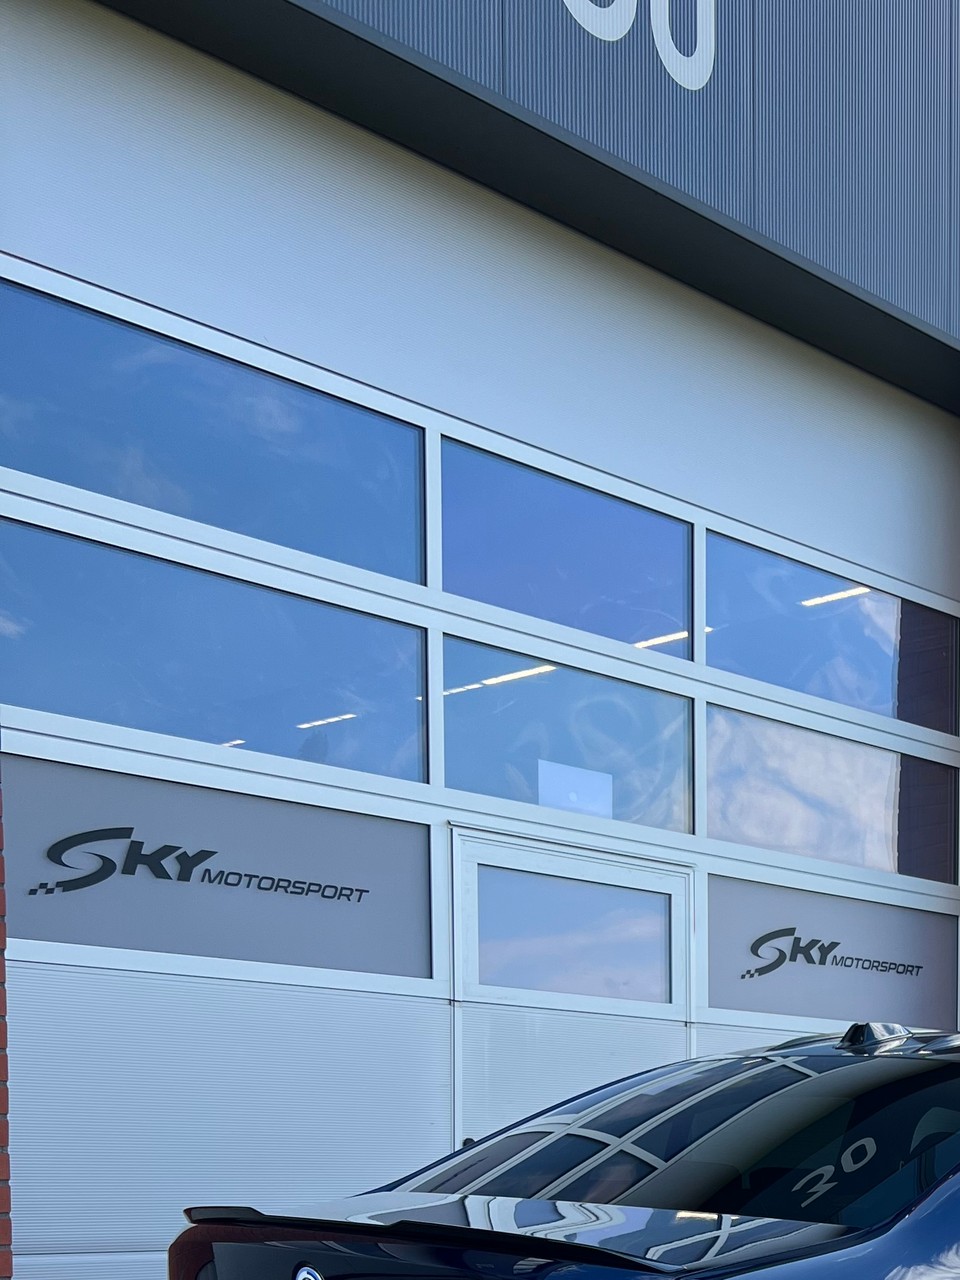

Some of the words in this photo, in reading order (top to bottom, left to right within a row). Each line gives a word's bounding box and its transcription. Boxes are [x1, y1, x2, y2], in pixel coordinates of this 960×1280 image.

[28, 827, 219, 896] SKY
[201, 868, 370, 904] MOTORSPORT
[741, 927, 841, 979] SKY
[831, 955, 923, 977] MOTORSPORT
